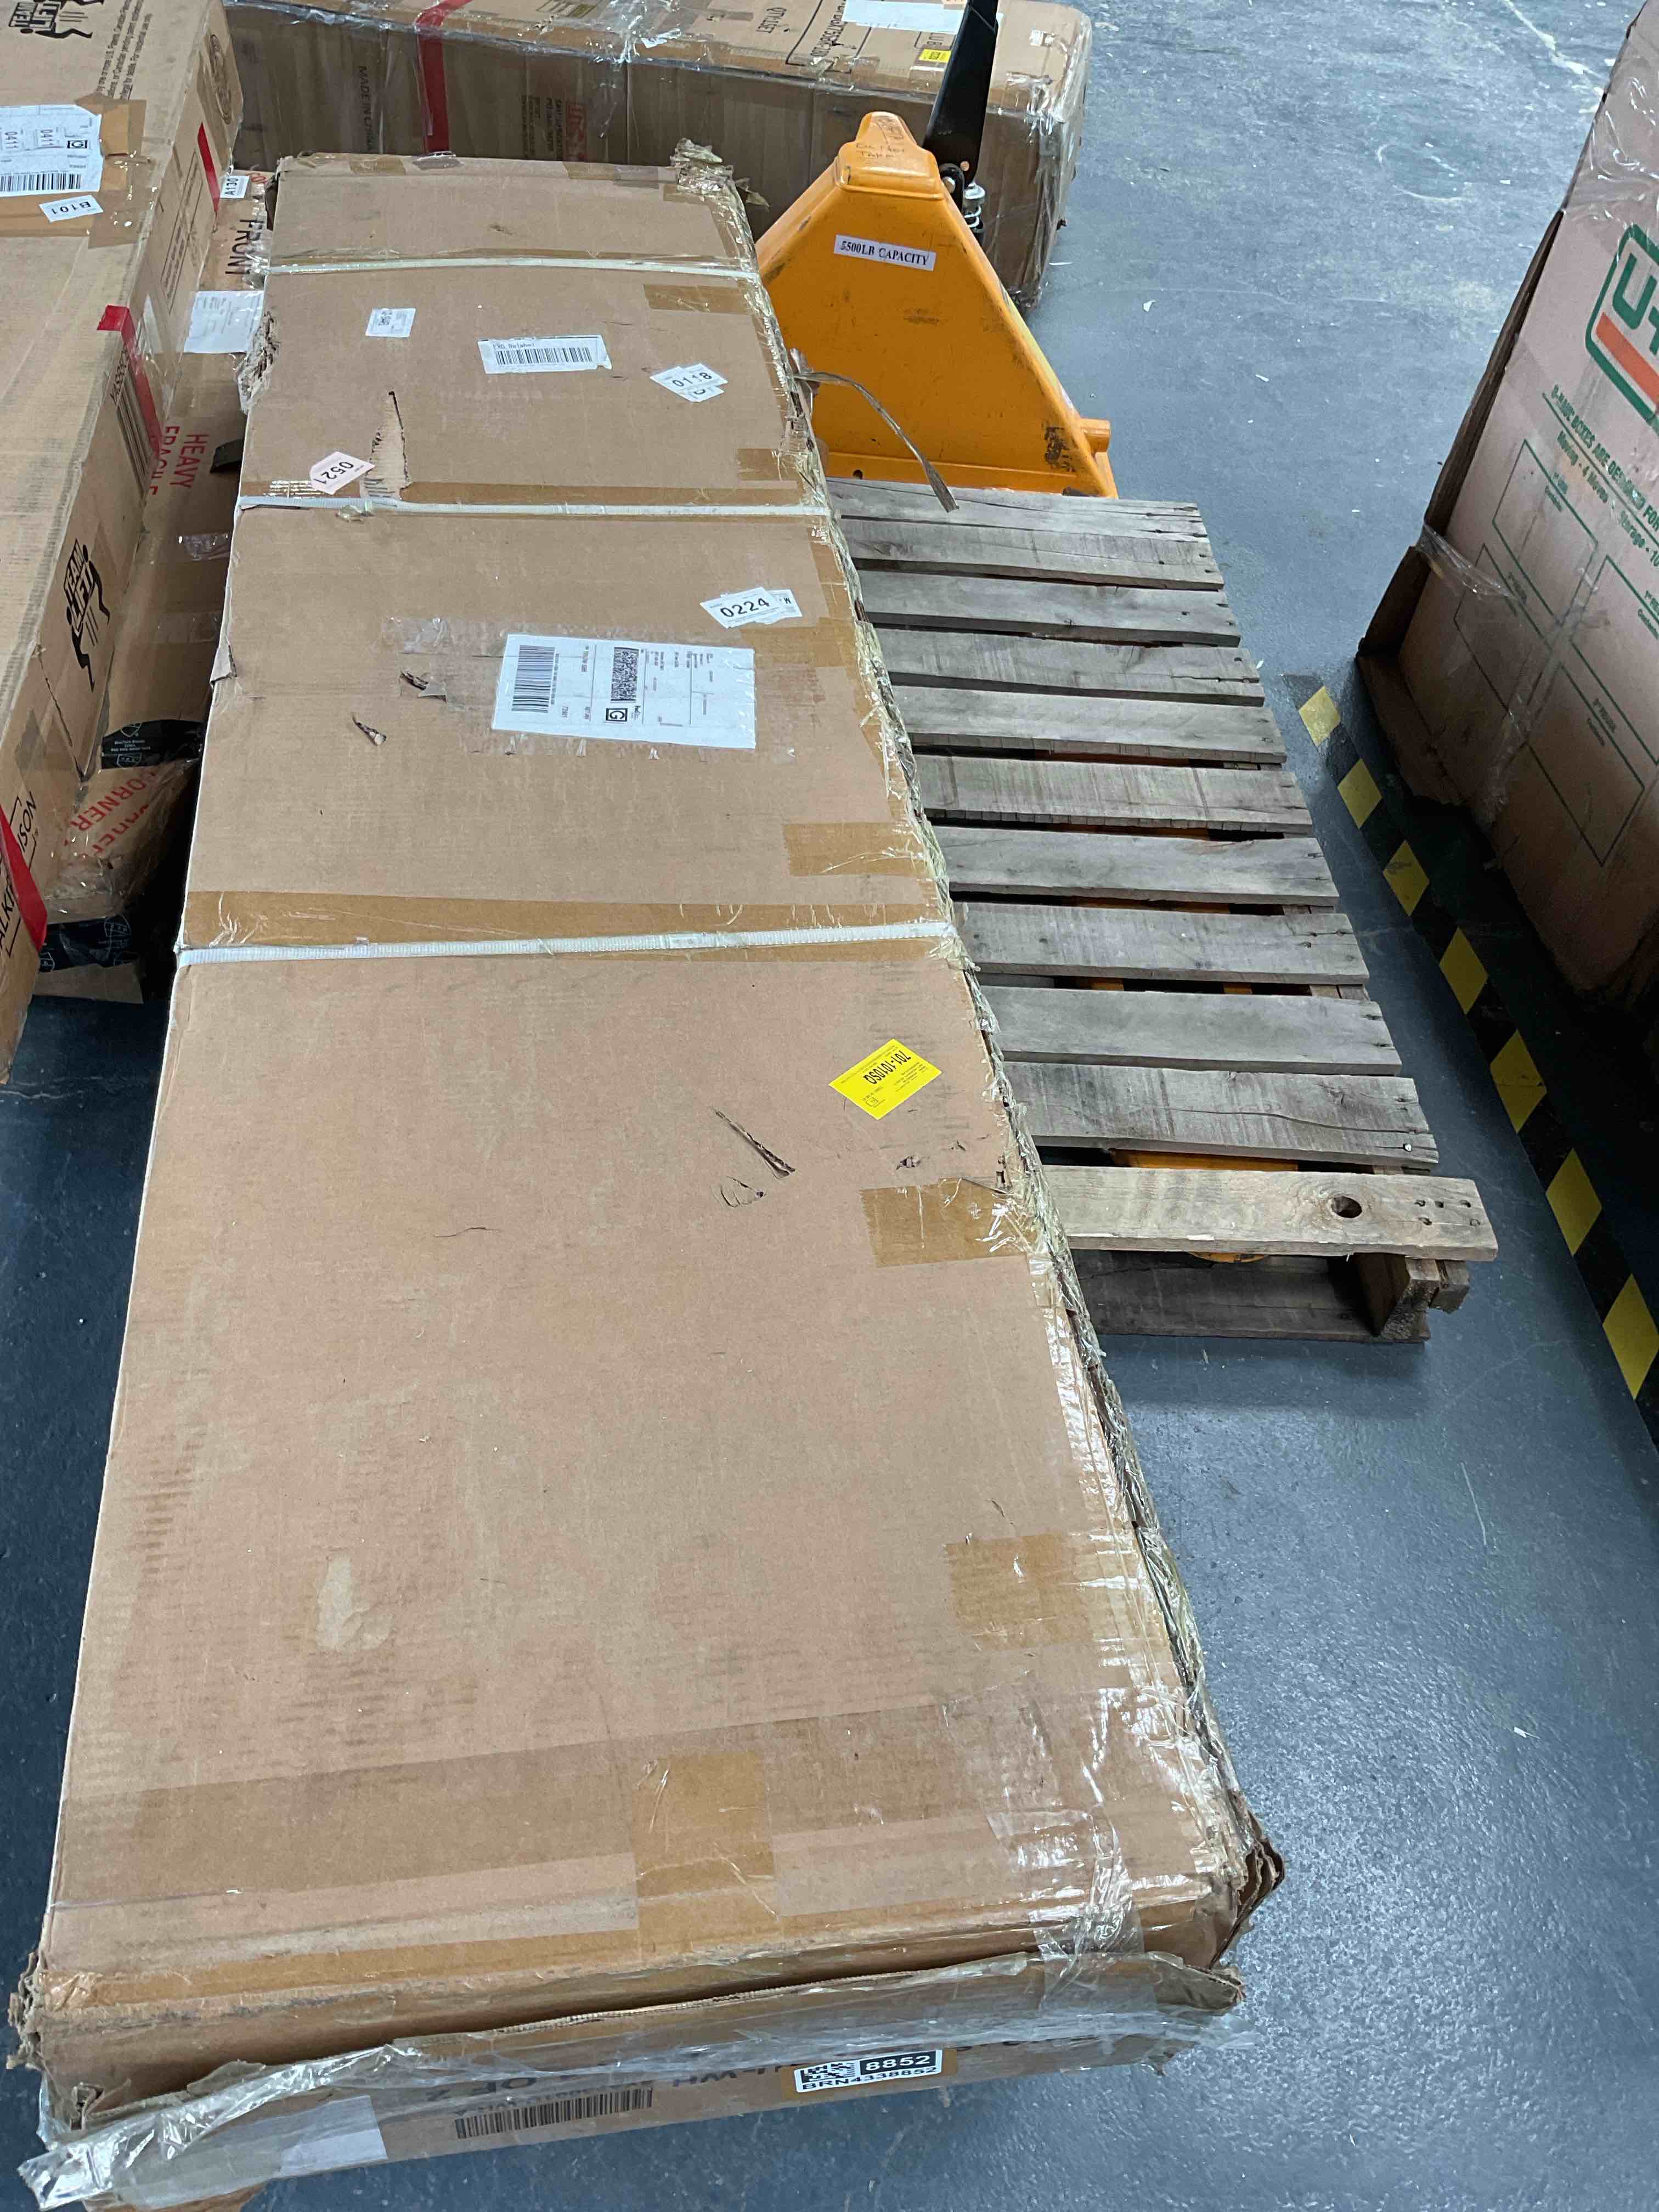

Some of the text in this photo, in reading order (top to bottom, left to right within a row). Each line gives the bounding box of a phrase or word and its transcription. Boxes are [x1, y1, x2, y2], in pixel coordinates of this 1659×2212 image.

[358, 65, 371, 101] MADE
[224, 178, 239, 196] A130
[51, 201, 91, 215] B101
[840, 240, 930, 266] 5500LB CAPACITY
[672, 371, 713, 387] 0118
[169, 433, 209, 489] HEAVY
[314, 460, 354, 485] 0521
[1619, 510, 1645, 548] Storage
[720, 597, 770, 618] 0224
[70, 770, 157, 831] ORNER
[18, 791, 37, 853] ISON
[865, 2055, 931, 2072] 8852
[802, 2066, 937, 2090] BRN4338852
